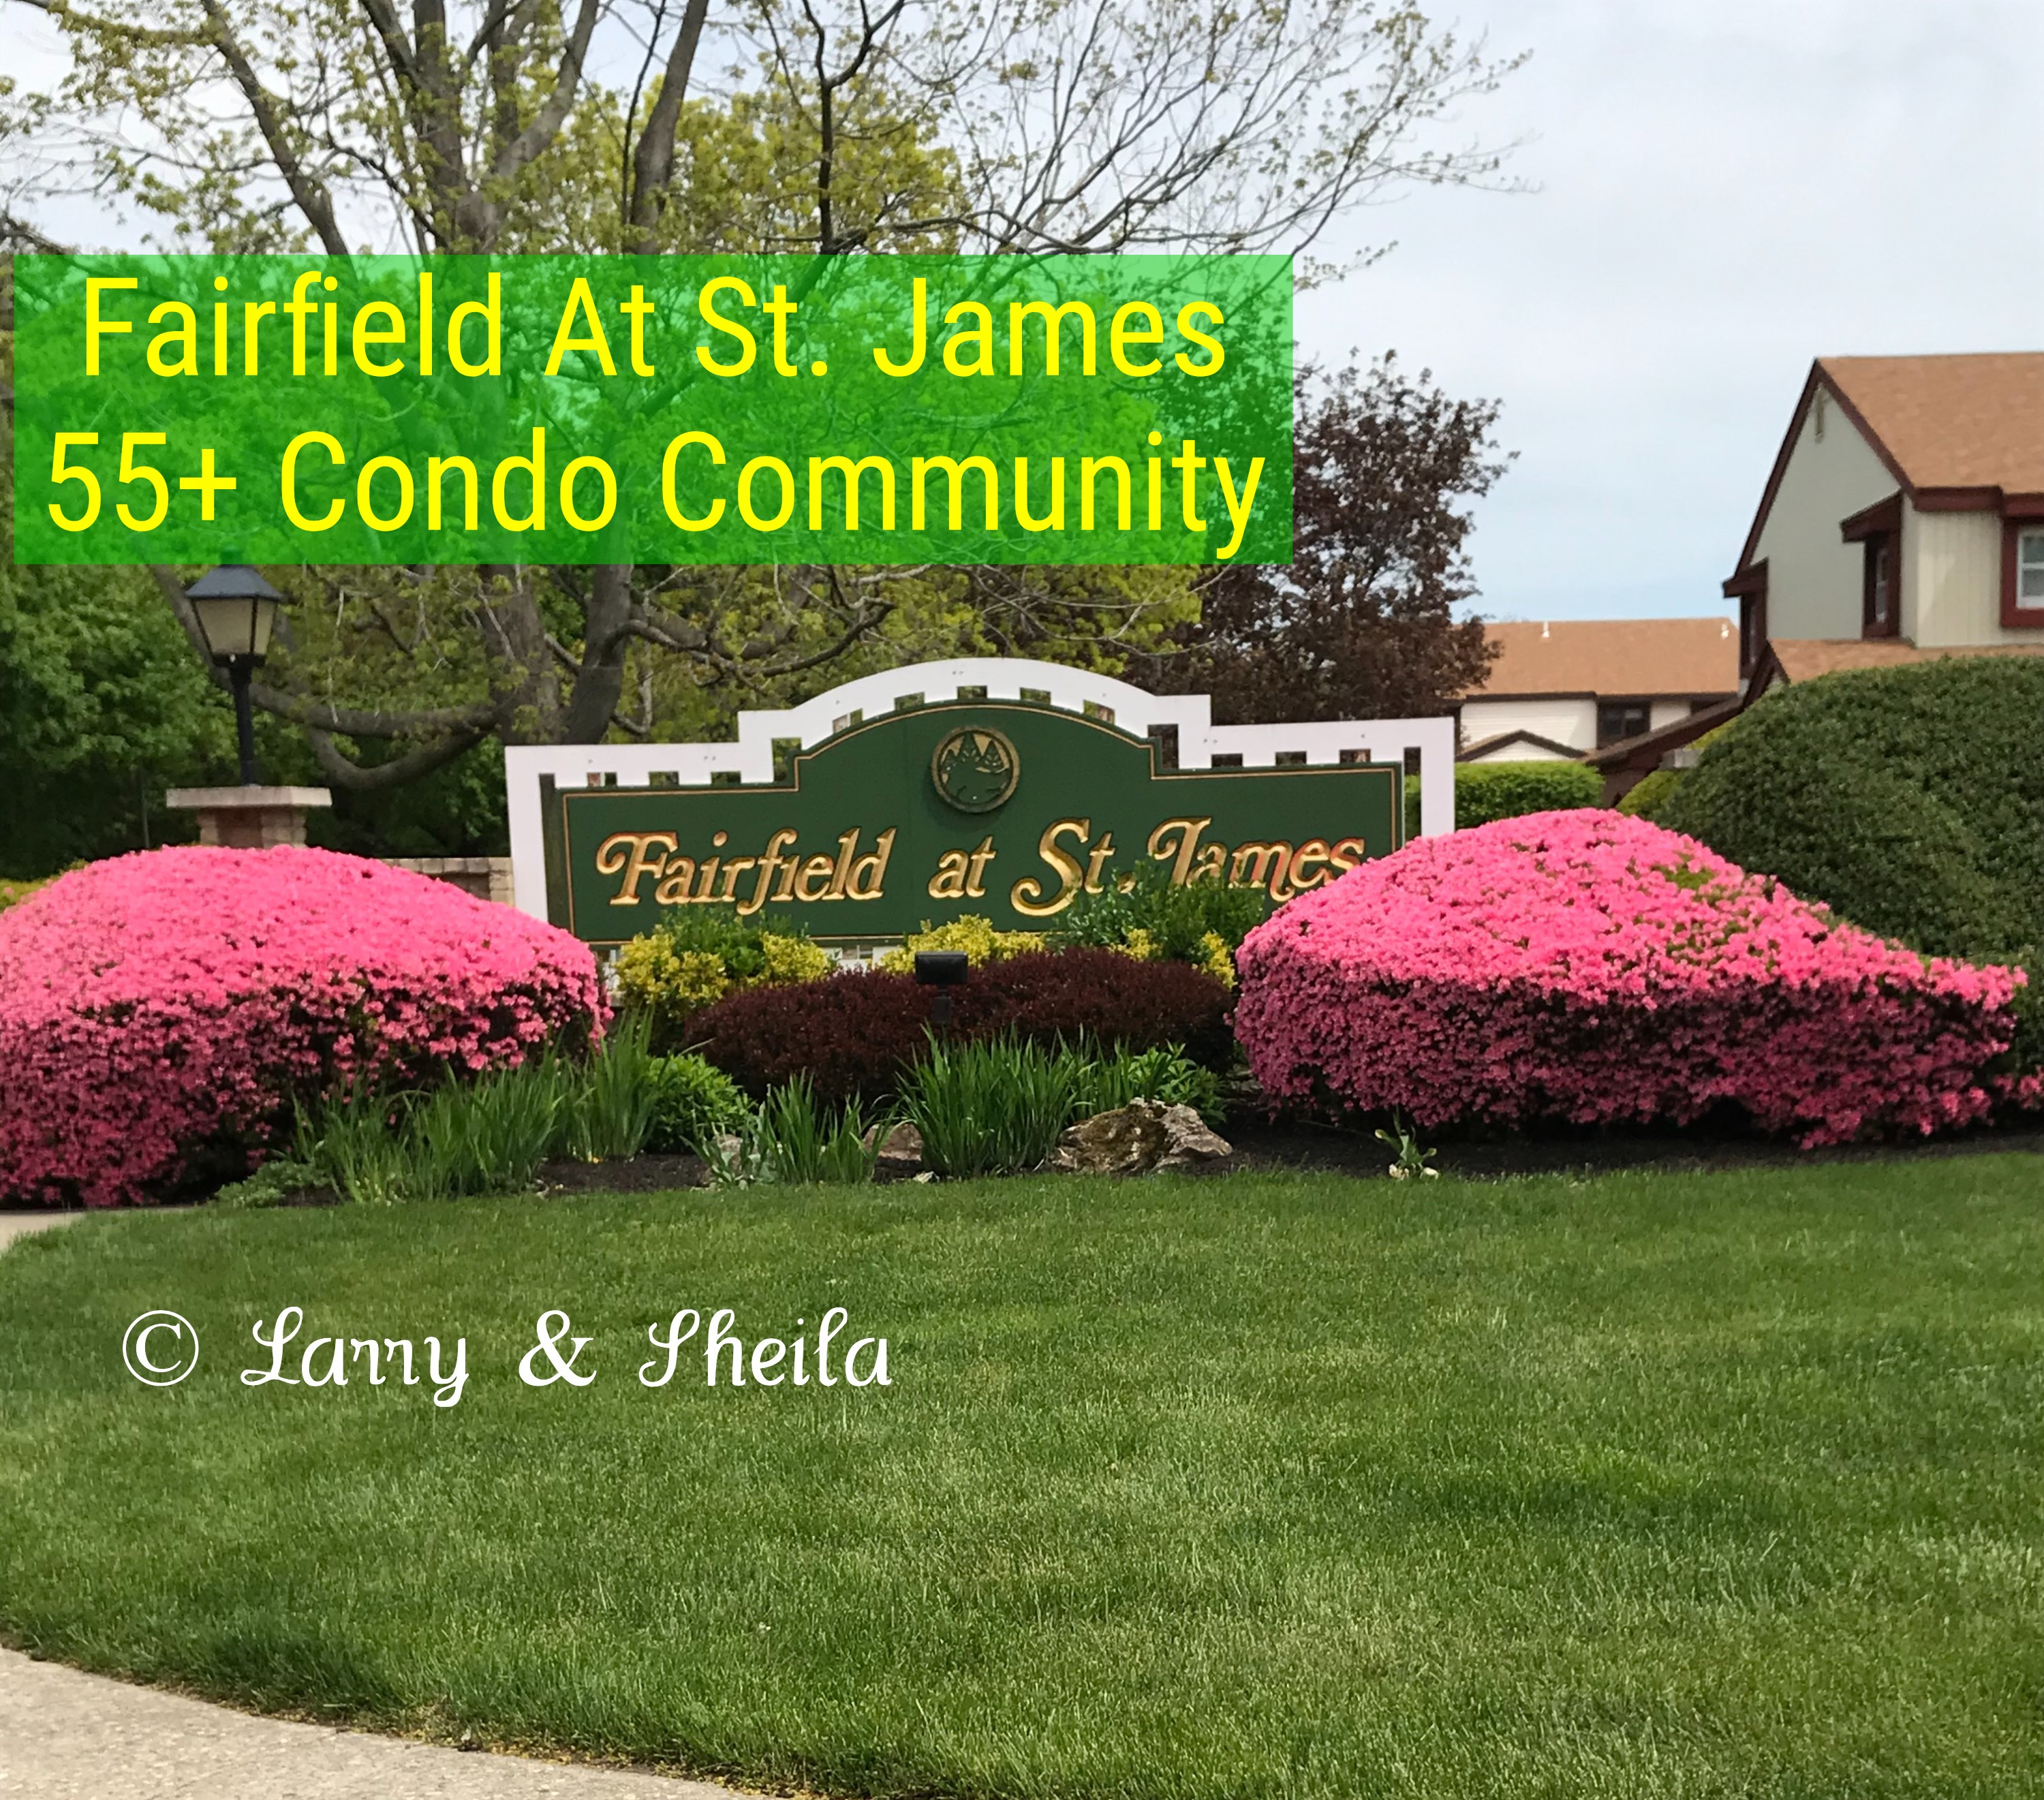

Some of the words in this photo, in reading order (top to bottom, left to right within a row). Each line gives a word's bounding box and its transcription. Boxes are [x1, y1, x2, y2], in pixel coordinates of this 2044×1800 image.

[595, 826, 897, 915] Fairfield
[928, 835, 997, 899] at
[1148, 817, 1365, 902] James
